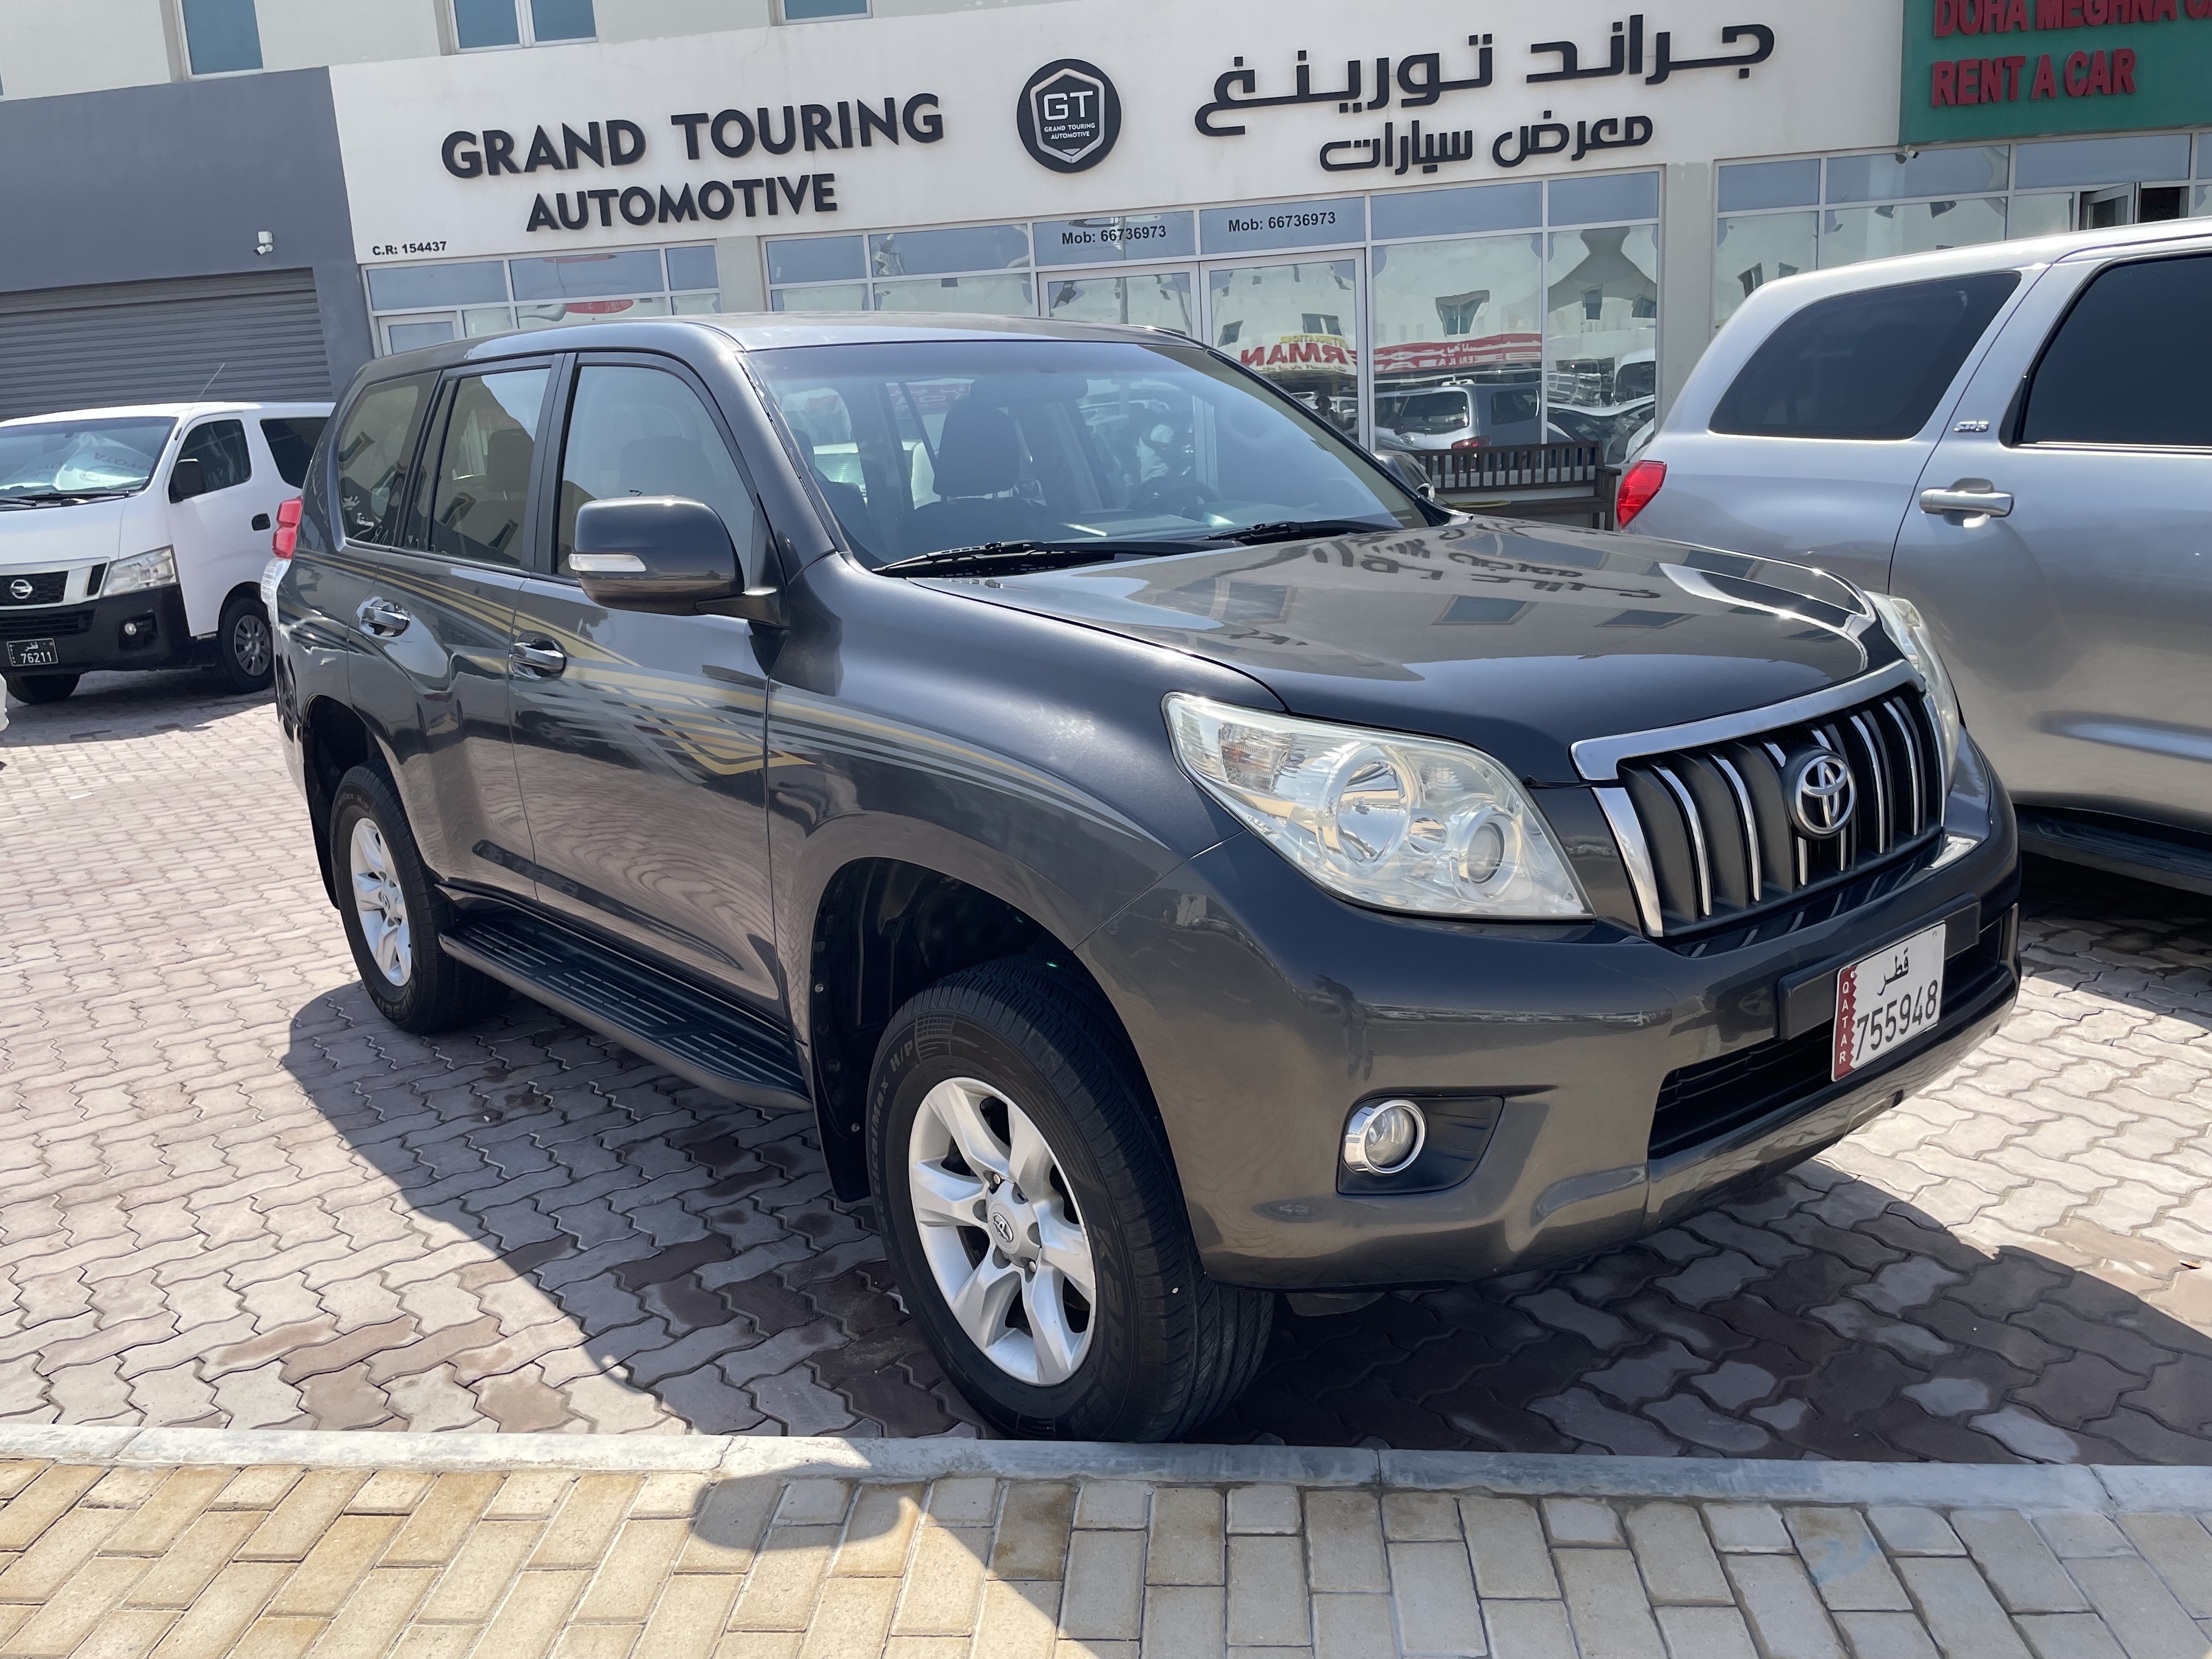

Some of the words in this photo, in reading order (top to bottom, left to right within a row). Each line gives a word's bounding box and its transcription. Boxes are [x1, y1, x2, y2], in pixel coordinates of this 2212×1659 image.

[1934, 0, 2029, 37] DOHA
[1526, 14, 1775, 84] جراند
[1194, 32, 1493, 137] تورينغ
[1932, 55, 2026, 107] RENT
[2032, 53, 2057, 100] A
[2064, 48, 2137, 98] CAR
[1043, 91, 1093, 121] GT
[1068, 122, 1096, 131] TOURING
[441, 119, 646, 178] GRAND
[670, 93, 944, 160] TOURING
[1051, 131, 1090, 140] AUTOMOTIVE
[1319, 119, 1474, 176] سيارات
[1492, 110, 1653, 168] معرض
[527, 173, 837, 232] AUTOMOTIVE
[1228, 218, 1263, 233] Mob:
[1268, 211, 1336, 229] 66736973
[372, 245, 398, 256] C.R:
[402, 241, 447, 254] 154437
[1062, 231, 1096, 245] Mob:
[1101, 225, 1166, 242] 66736973
[20, 651, 52, 664] 76211
[1877, 947, 1910, 996] قطر
[1838, 981, 1850, 1064] QATAR
[1855, 979, 1938, 1062] 755948
[890, 1040, 913, 1072] H/P
